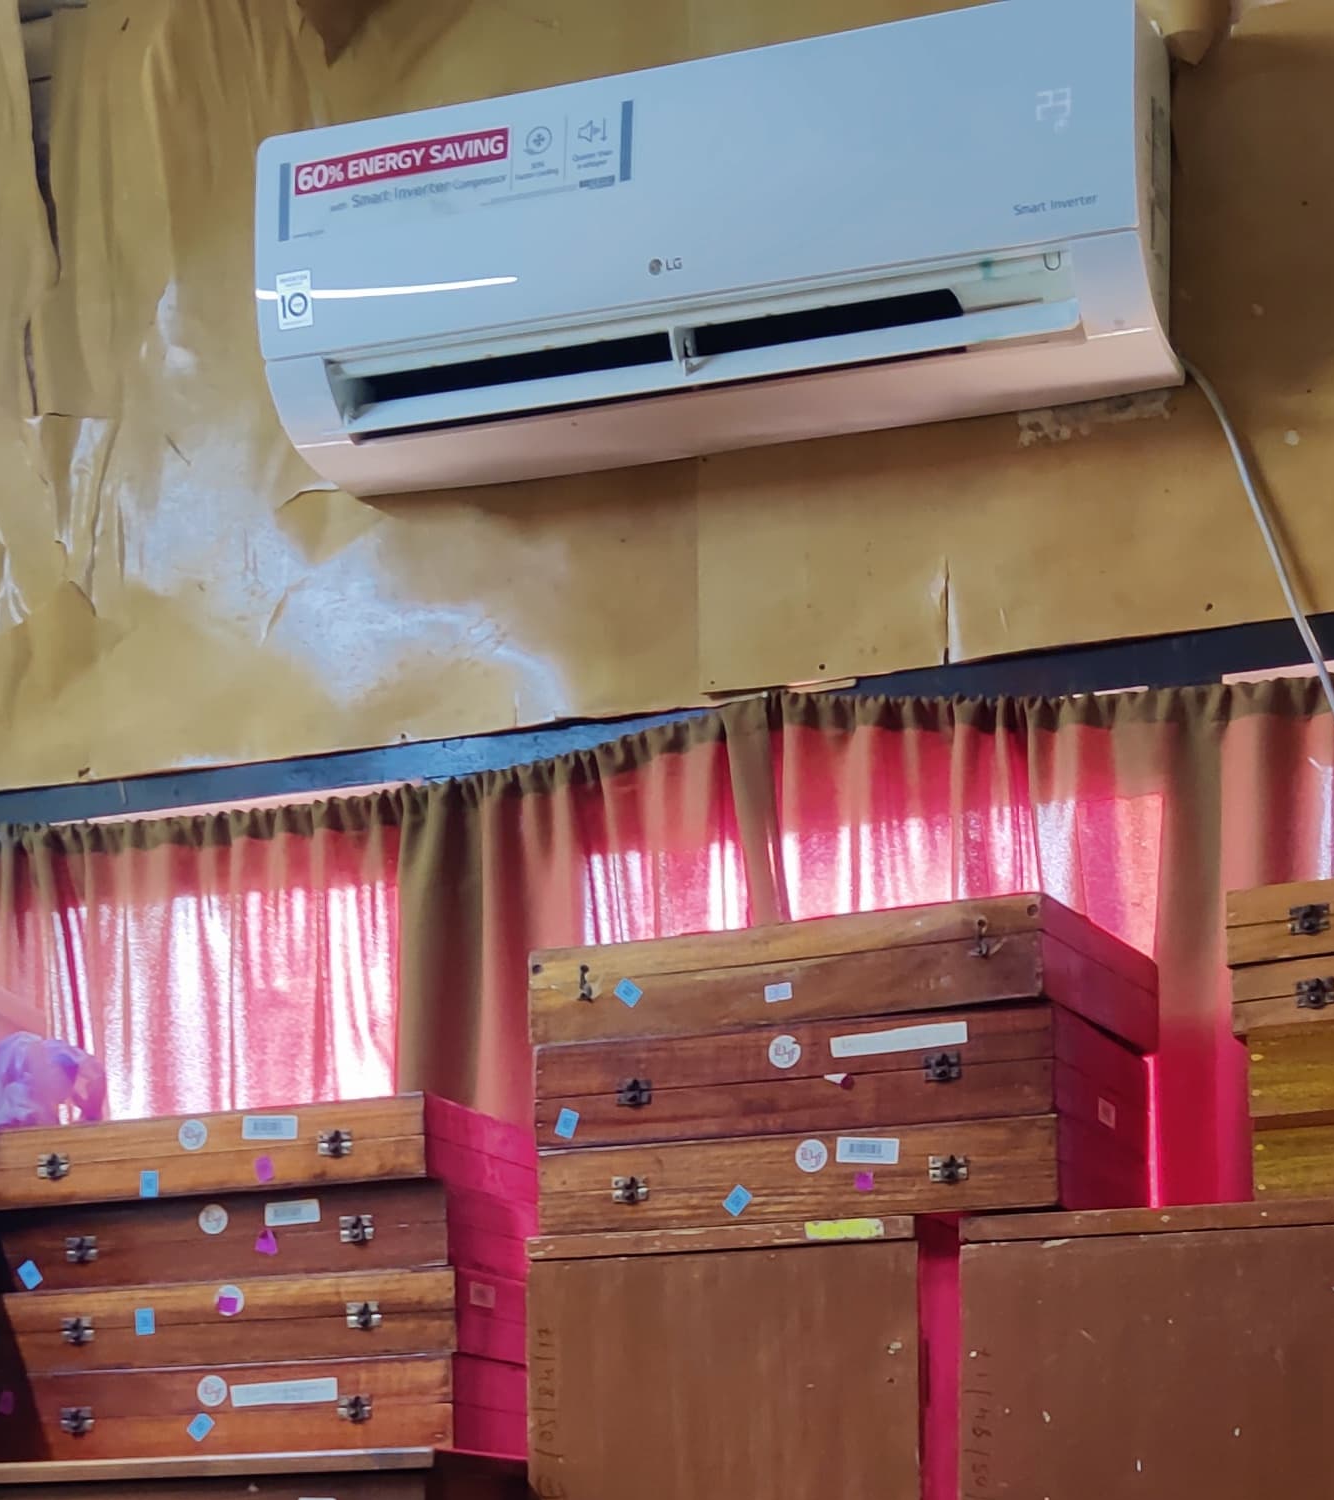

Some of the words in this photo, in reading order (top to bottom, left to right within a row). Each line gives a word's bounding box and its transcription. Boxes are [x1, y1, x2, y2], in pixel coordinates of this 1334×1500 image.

[297, 164, 344, 191] 60%
[347, 148, 427, 179] ENERGY
[429, 135, 505, 163] SAVING
[352, 192, 389, 208] Smart
[394, 181, 451, 199] Inverter
[1012, 200, 1046, 216] Smart
[1050, 194, 1098, 211] Inverter
[665, 257, 683, 271] LG
